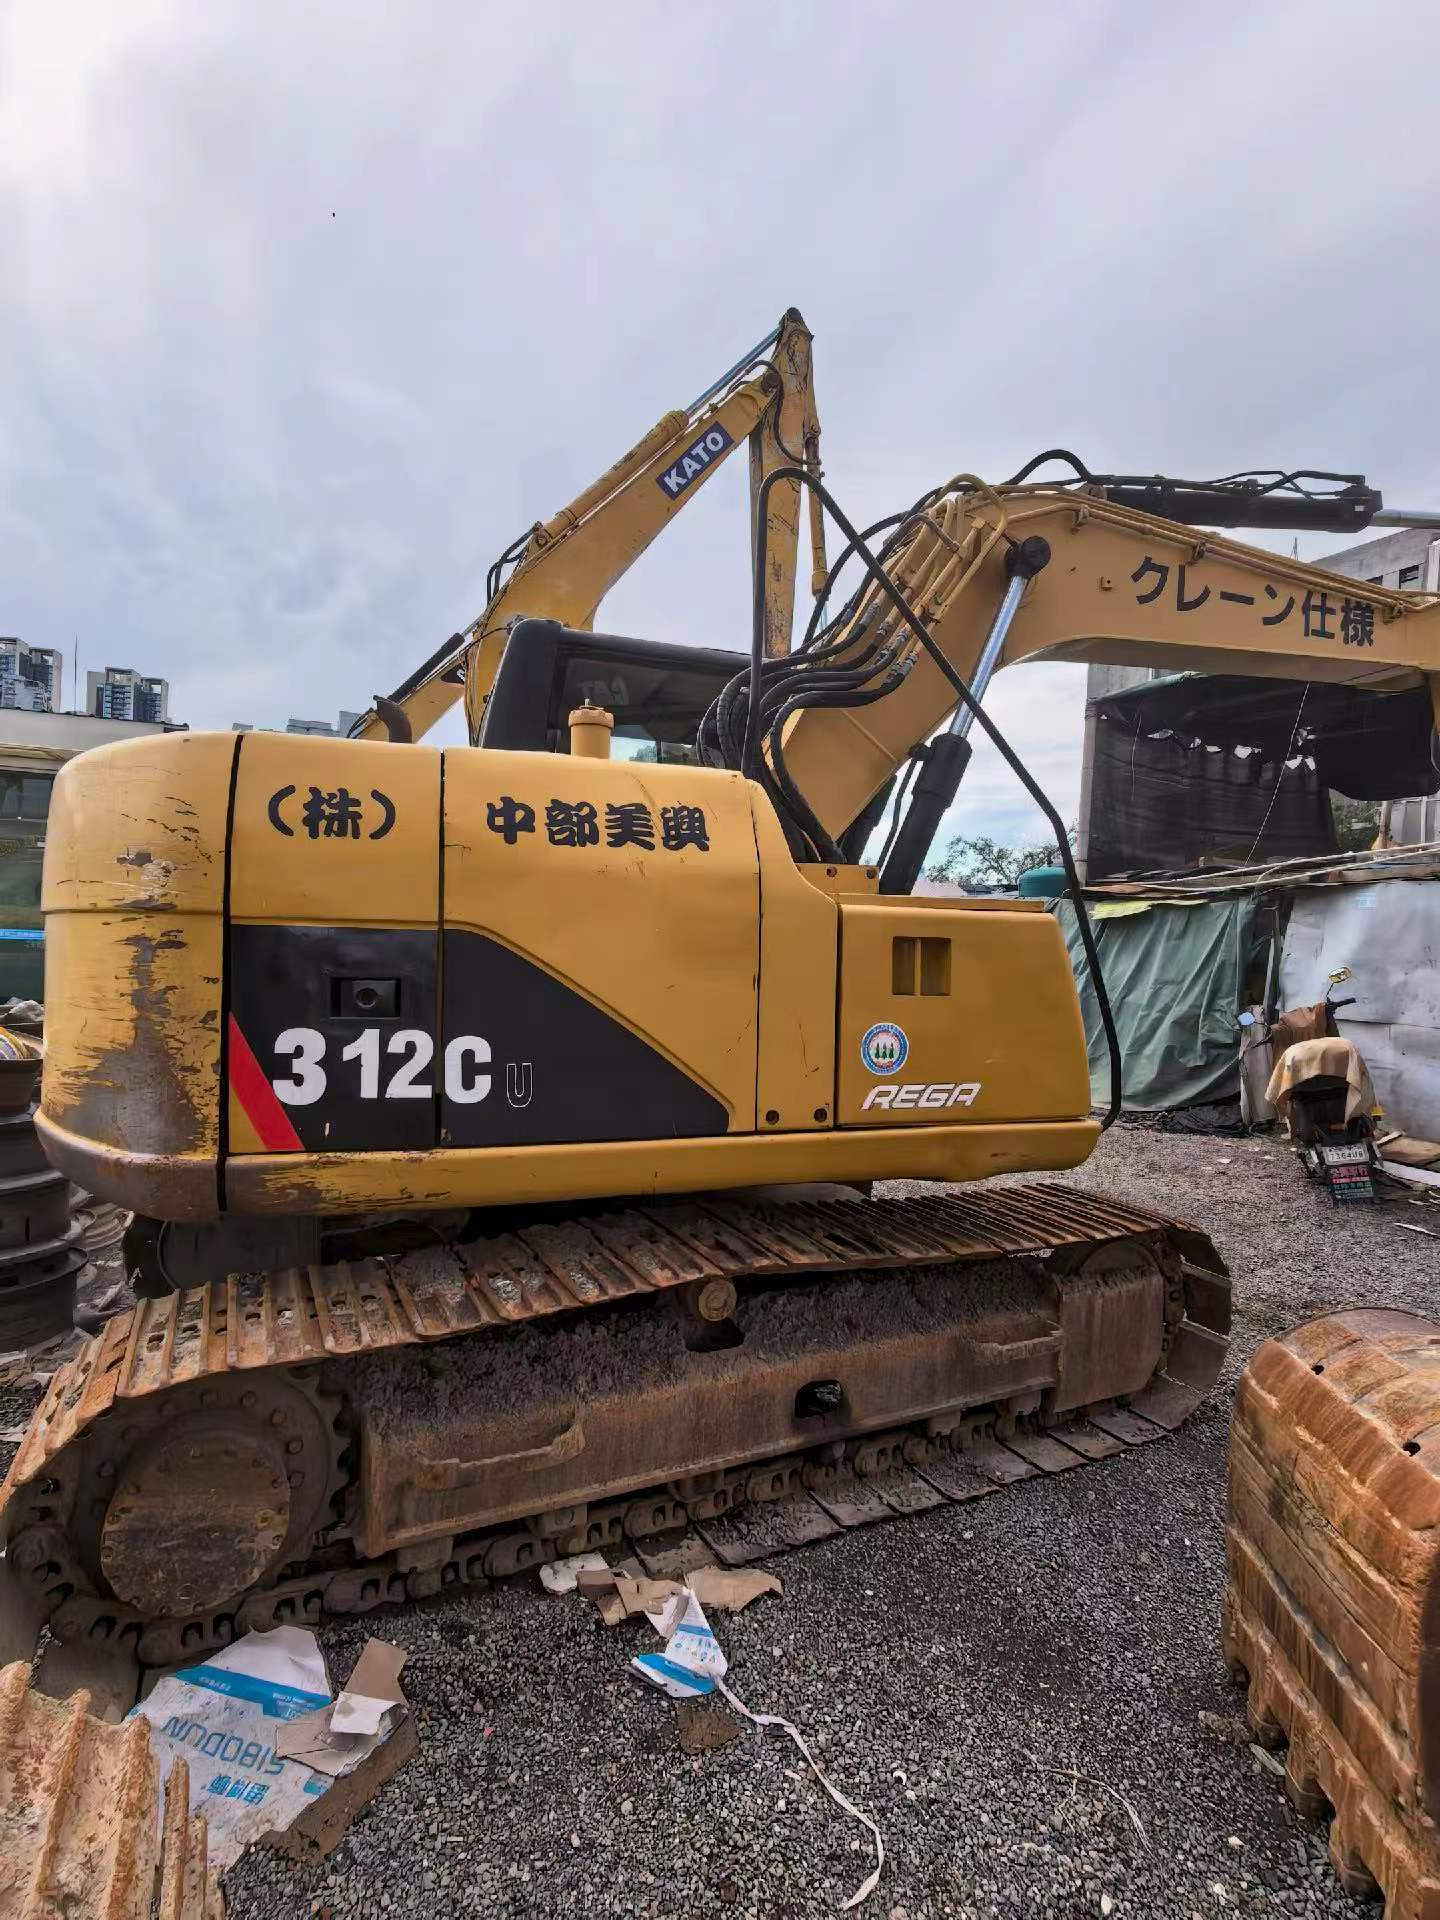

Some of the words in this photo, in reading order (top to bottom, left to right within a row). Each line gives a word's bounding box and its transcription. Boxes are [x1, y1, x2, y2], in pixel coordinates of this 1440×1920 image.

[663, 431, 724, 493] KATO
[1131, 556, 1375, 648] クレーン仕様
[860, 1082, 982, 1112] REGA
